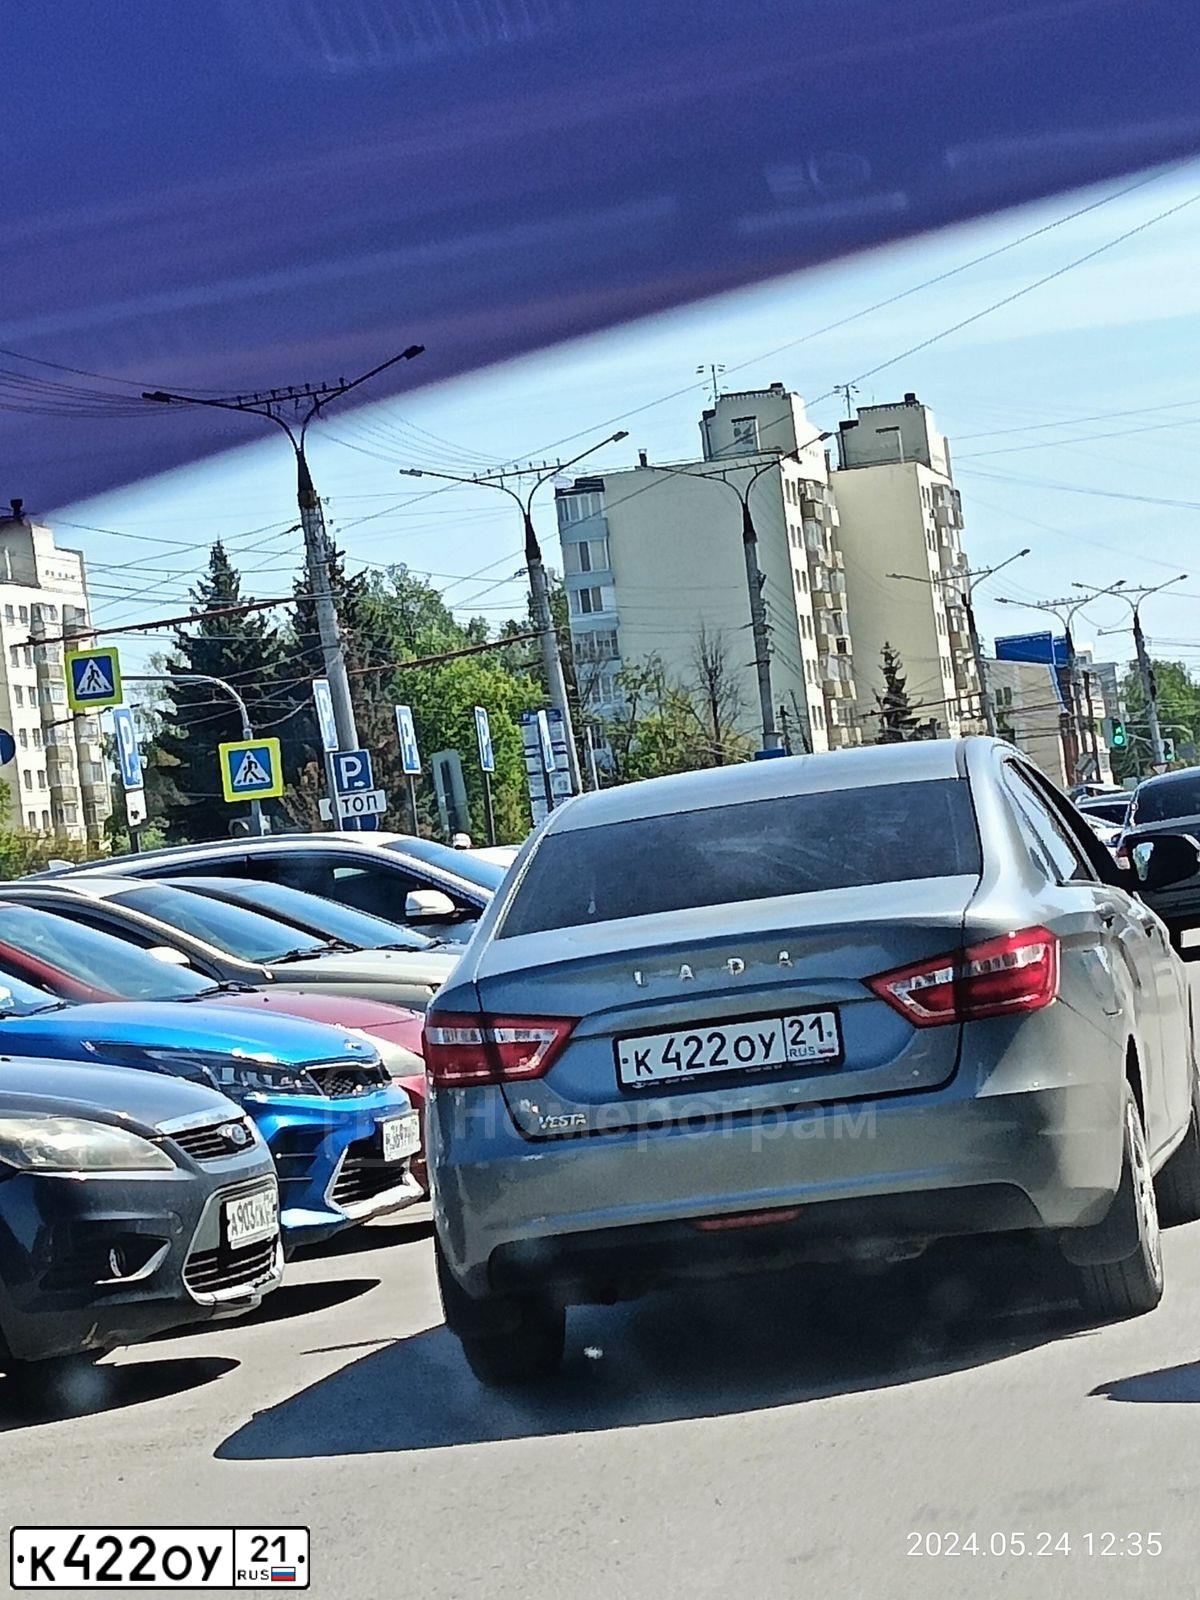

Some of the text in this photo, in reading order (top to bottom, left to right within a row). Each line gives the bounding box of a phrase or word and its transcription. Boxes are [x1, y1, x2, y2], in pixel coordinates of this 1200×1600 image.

[340, 756, 362, 789] P
[634, 1031, 776, 1076] К422ОУ
[788, 1015, 825, 1046] 21
[788, 1046, 816, 1058] RUS
[539, 1113, 587, 1131] VESTA
